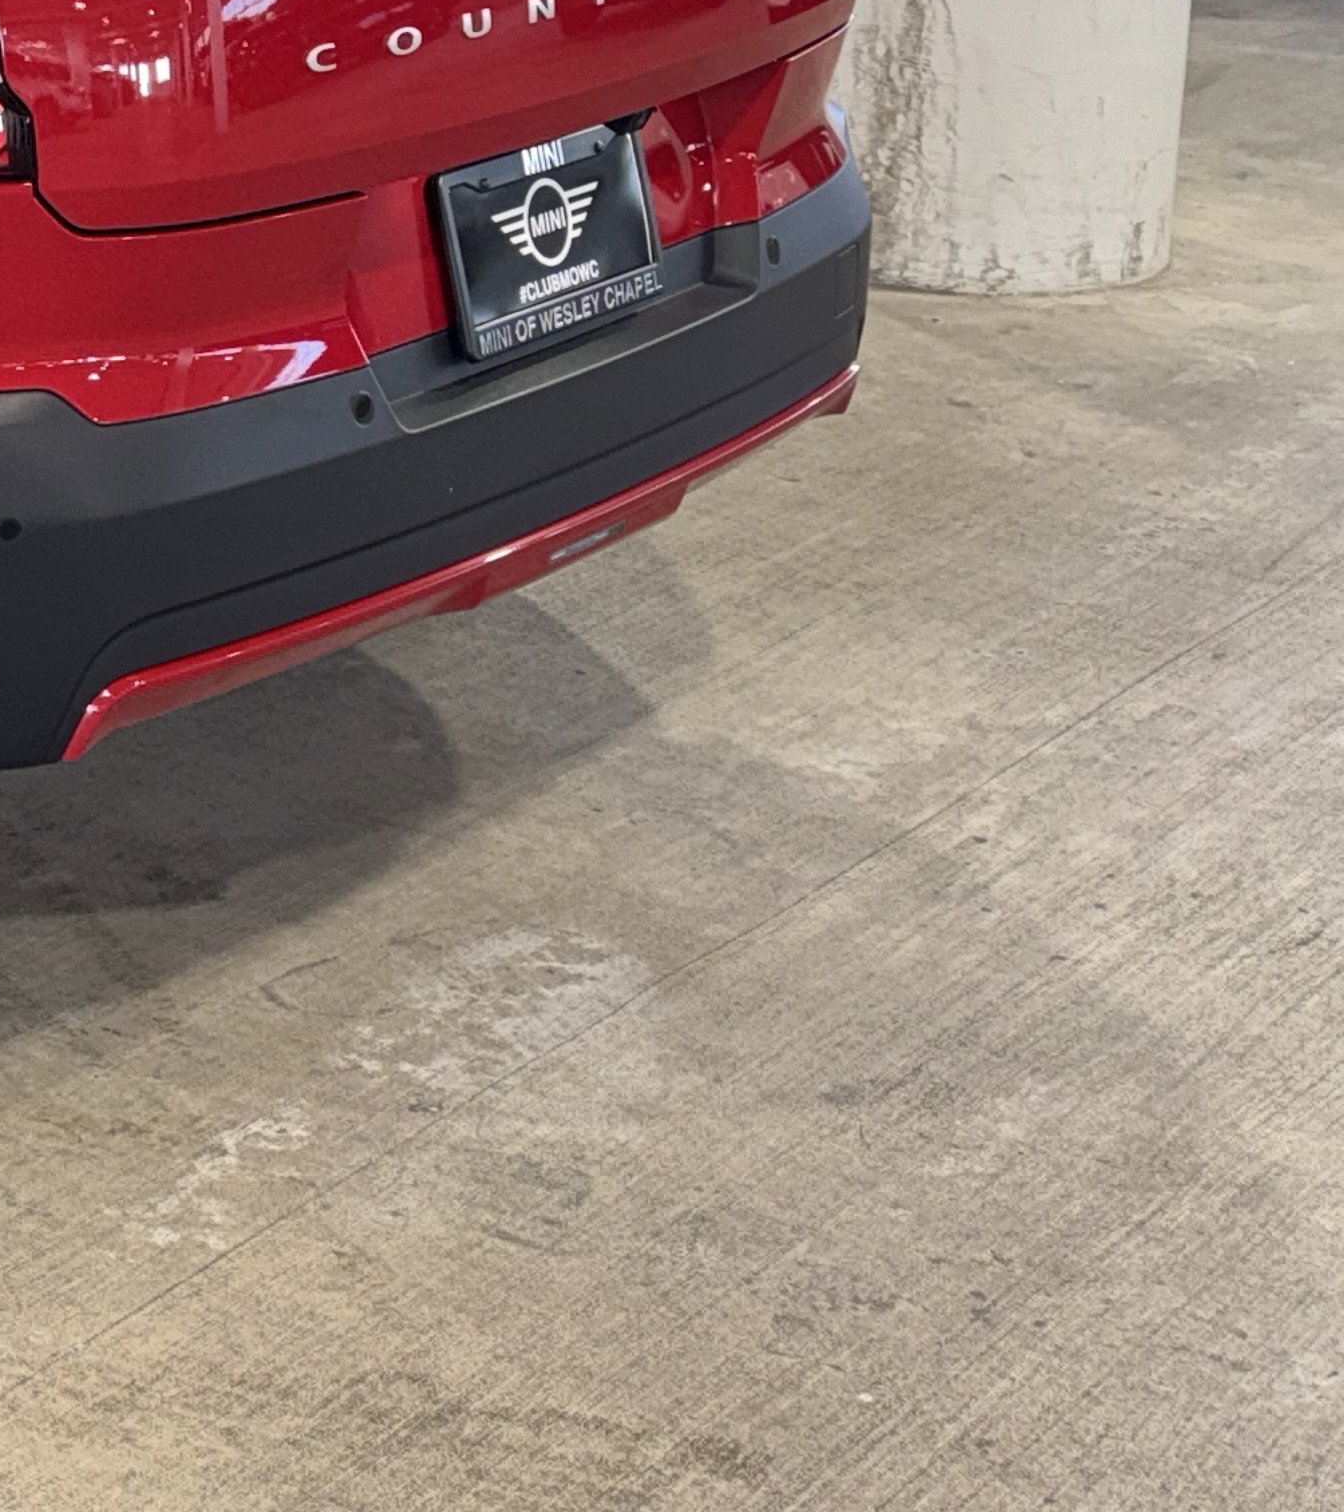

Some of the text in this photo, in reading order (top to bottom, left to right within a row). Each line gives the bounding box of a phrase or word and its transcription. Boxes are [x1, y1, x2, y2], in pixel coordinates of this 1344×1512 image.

[521, 139, 565, 176] MINI
[529, 206, 567, 238] MINI
[519, 260, 600, 303] #CLUBMOWC
[478, 271, 663, 357] MINI OF WESLEY CHAPEL
